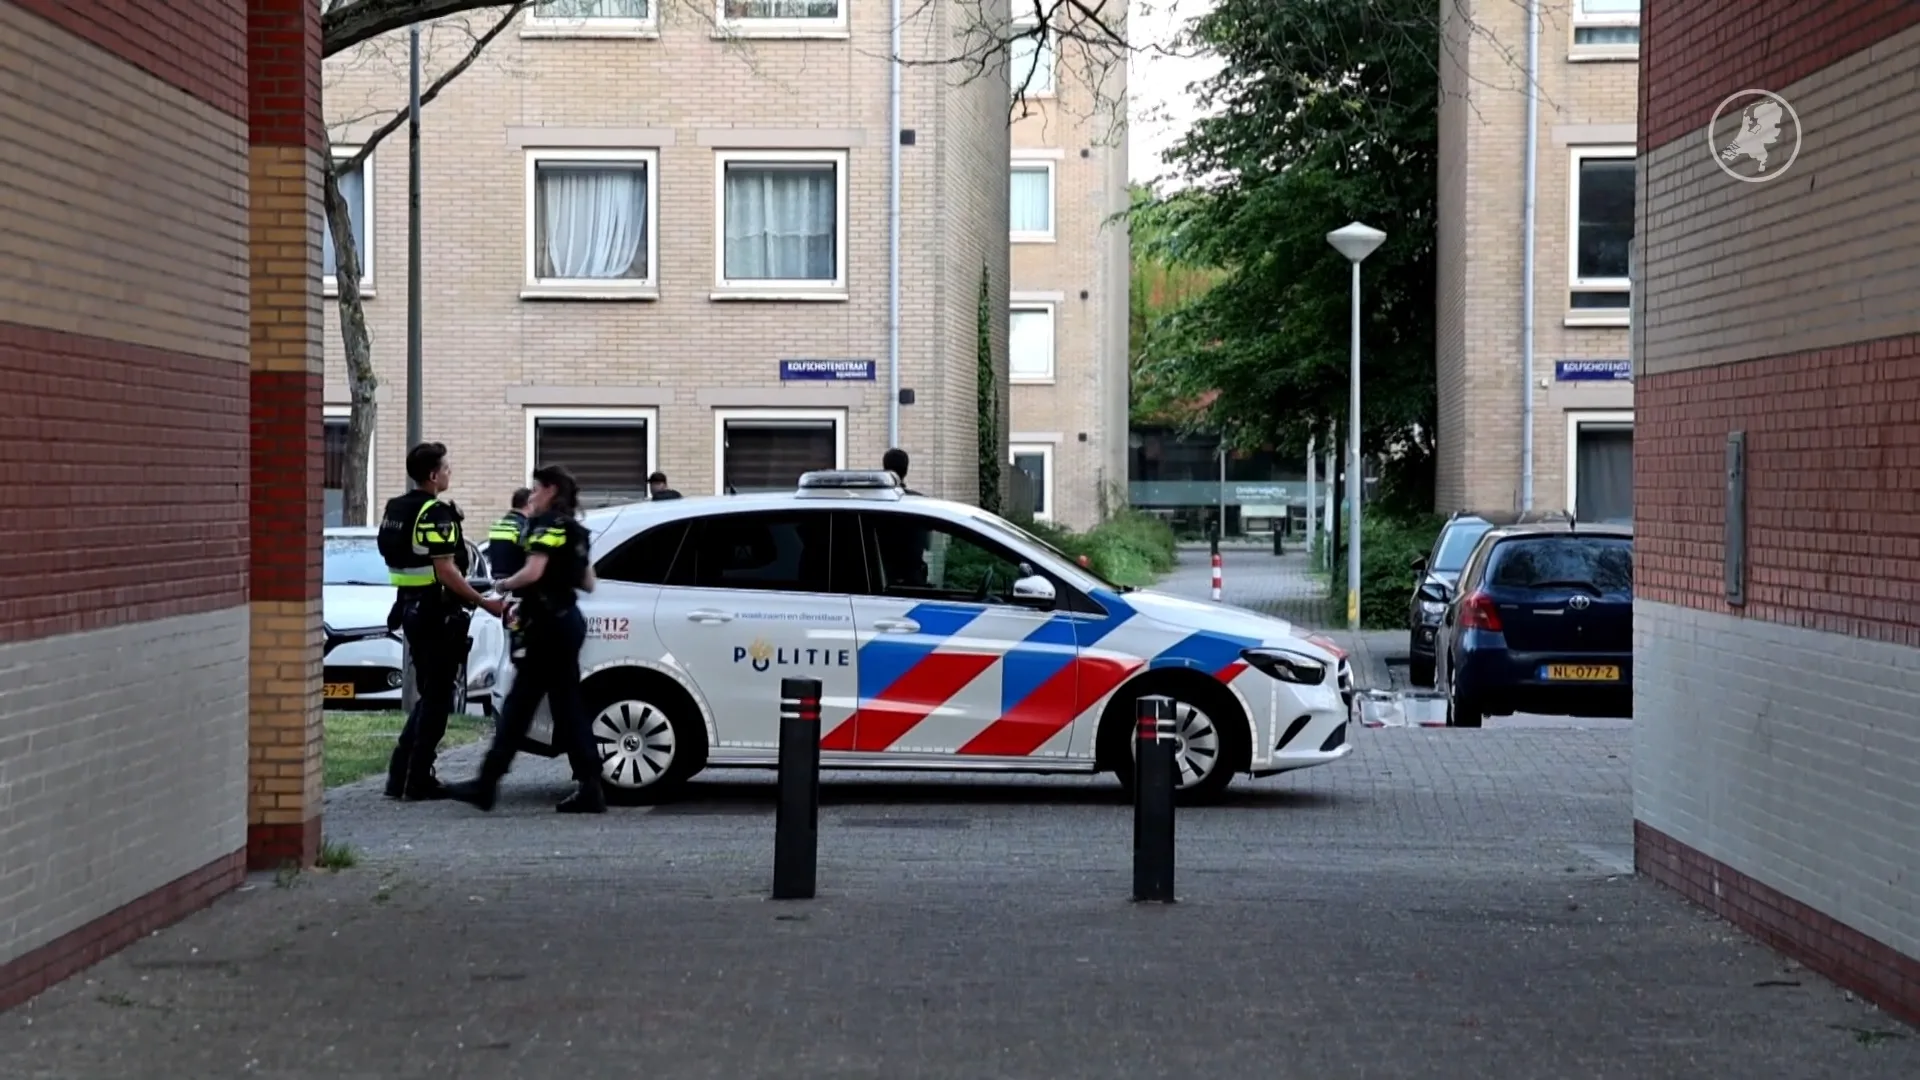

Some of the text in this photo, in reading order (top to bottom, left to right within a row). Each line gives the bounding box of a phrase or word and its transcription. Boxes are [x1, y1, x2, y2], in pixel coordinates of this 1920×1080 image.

[787, 361, 868, 371] KOLFSCHOTENSTRAAT
[604, 617, 629, 632] 112
[733, 646, 850, 672] POLITIE
[1553, 665, 1613, 679] NL-077-Z
